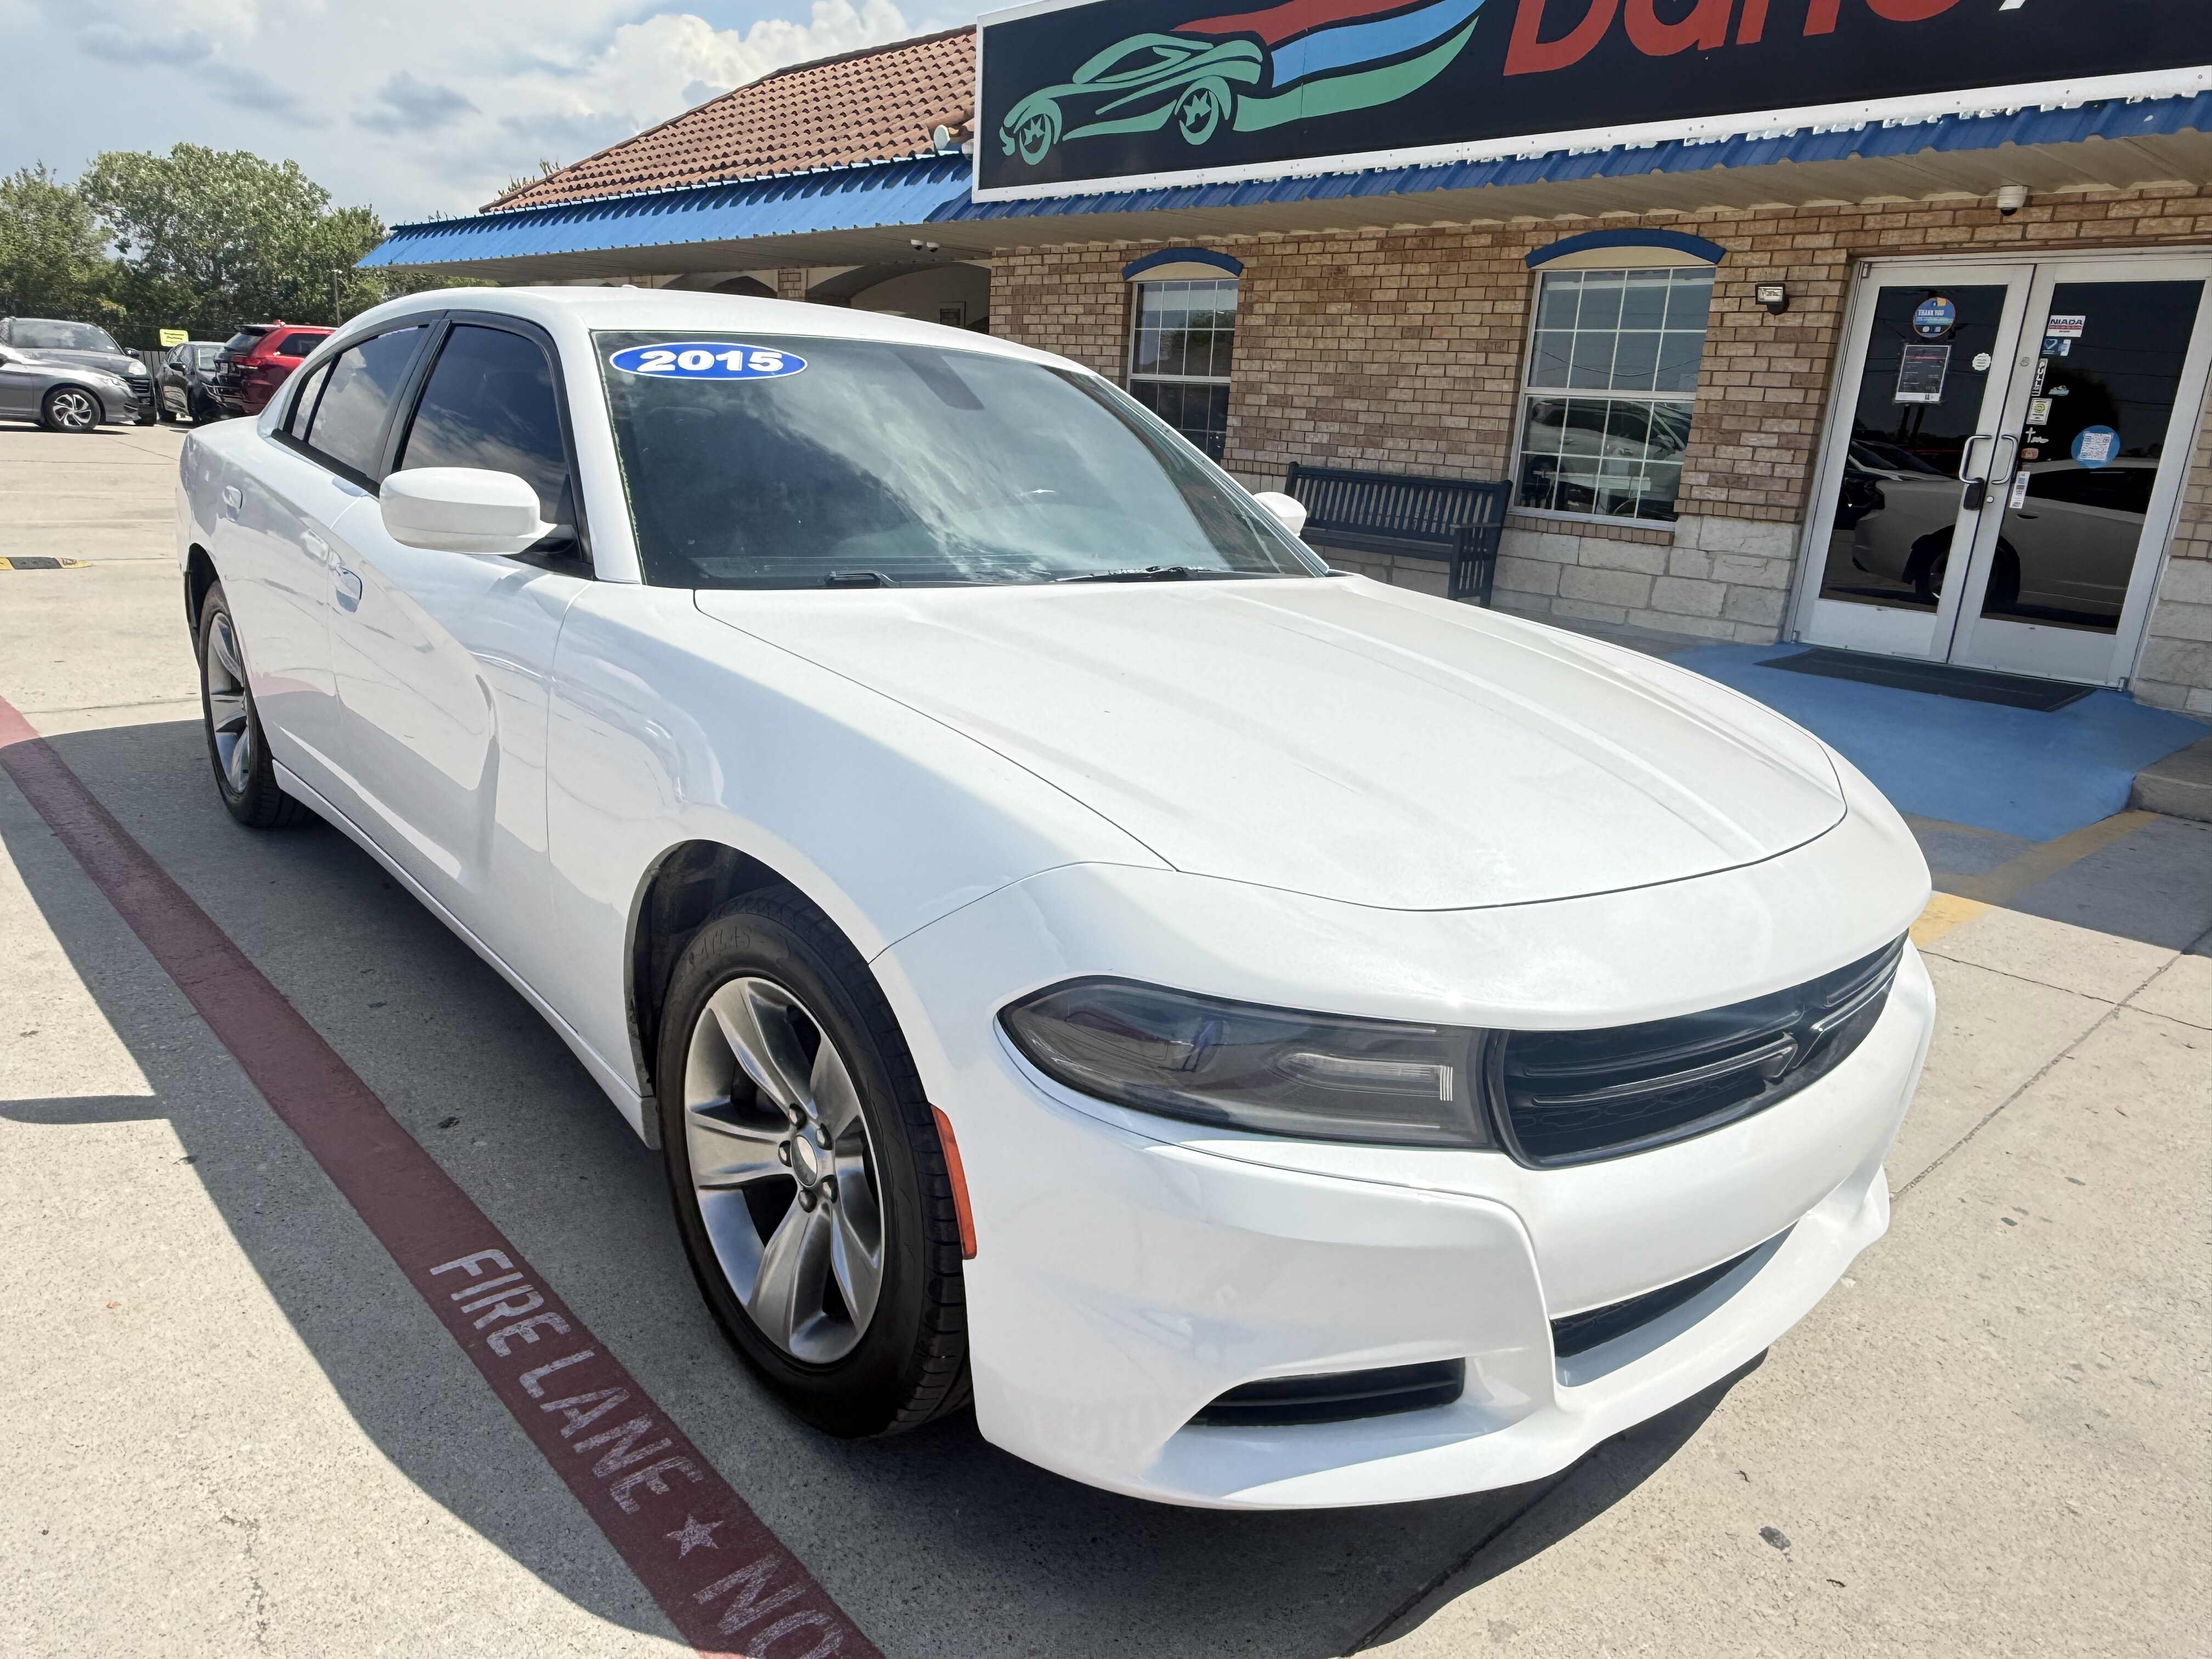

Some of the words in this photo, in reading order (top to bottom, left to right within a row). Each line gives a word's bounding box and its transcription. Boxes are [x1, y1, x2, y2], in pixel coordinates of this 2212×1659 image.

[636, 350, 784, 372] 2015
[430, 1249, 571, 1357] FIRE
[519, 1350, 705, 1514] LANE
[692, 1554, 845, 1659] NO
